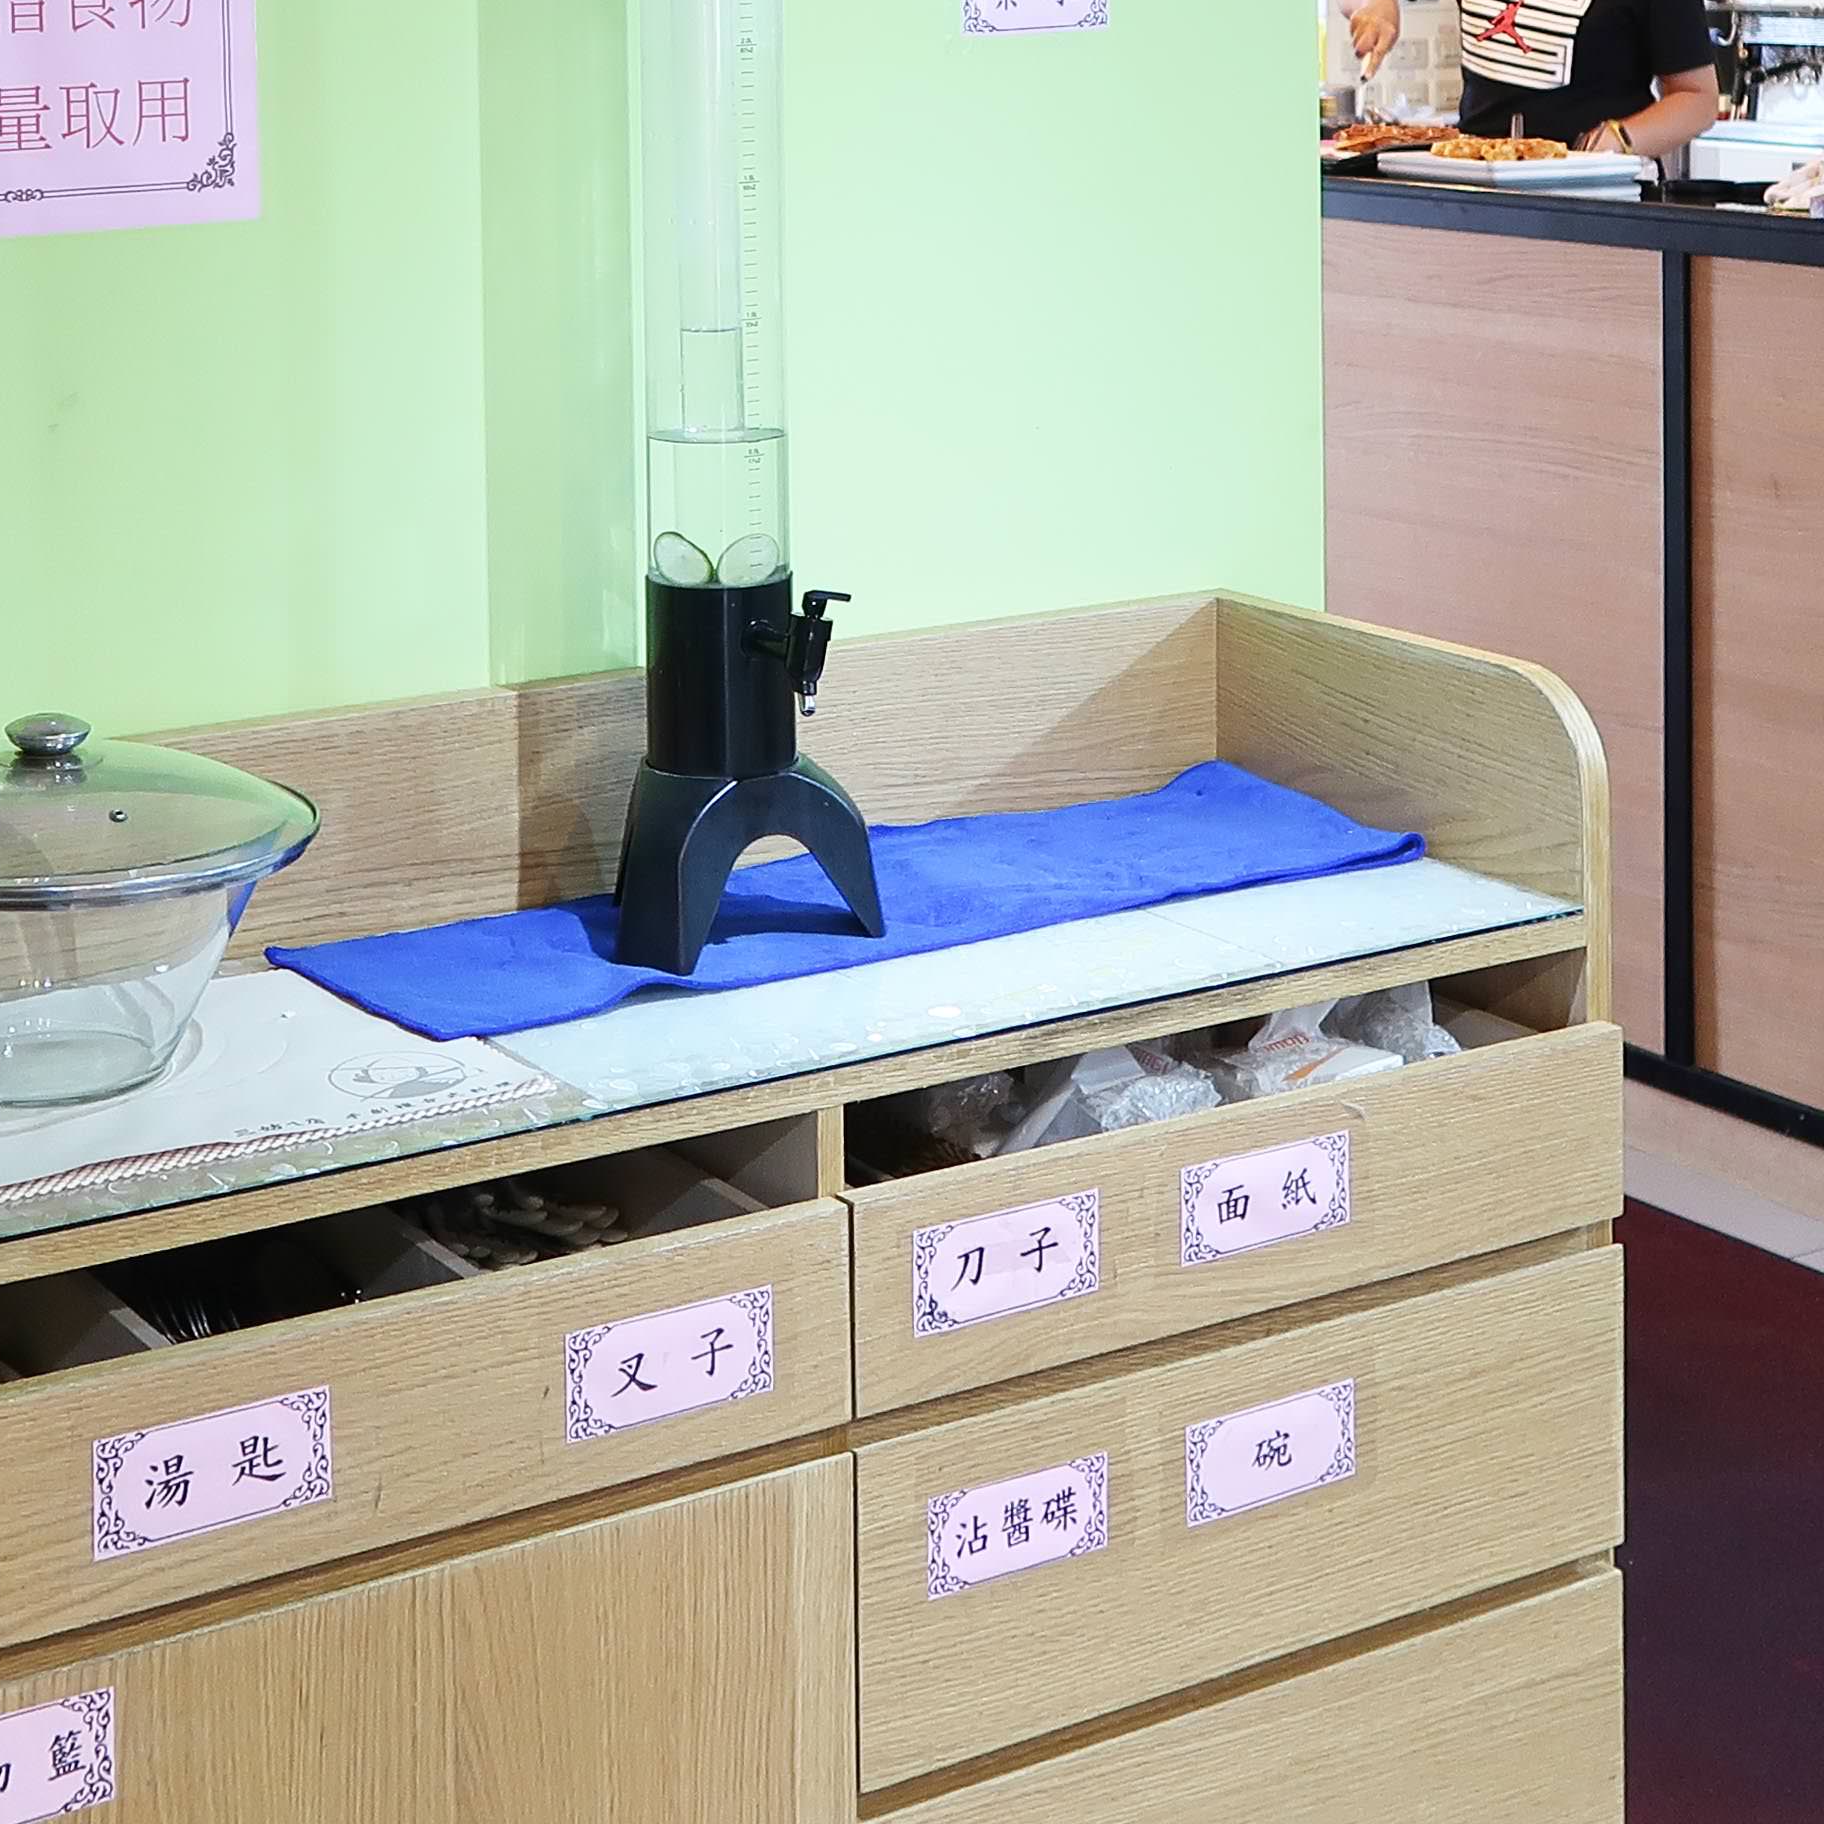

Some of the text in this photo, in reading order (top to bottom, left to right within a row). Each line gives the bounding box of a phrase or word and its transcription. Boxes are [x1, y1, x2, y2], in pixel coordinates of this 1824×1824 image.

[1216, 1168, 1317, 1225] 面紙
[950, 1226, 1059, 1292] 刀子
[610, 1327, 734, 1399] 叉子
[143, 1433, 288, 1511] 湯匙
[1251, 1430, 1293, 1471] 碗
[955, 1486, 1078, 1559] 沾醬碟
